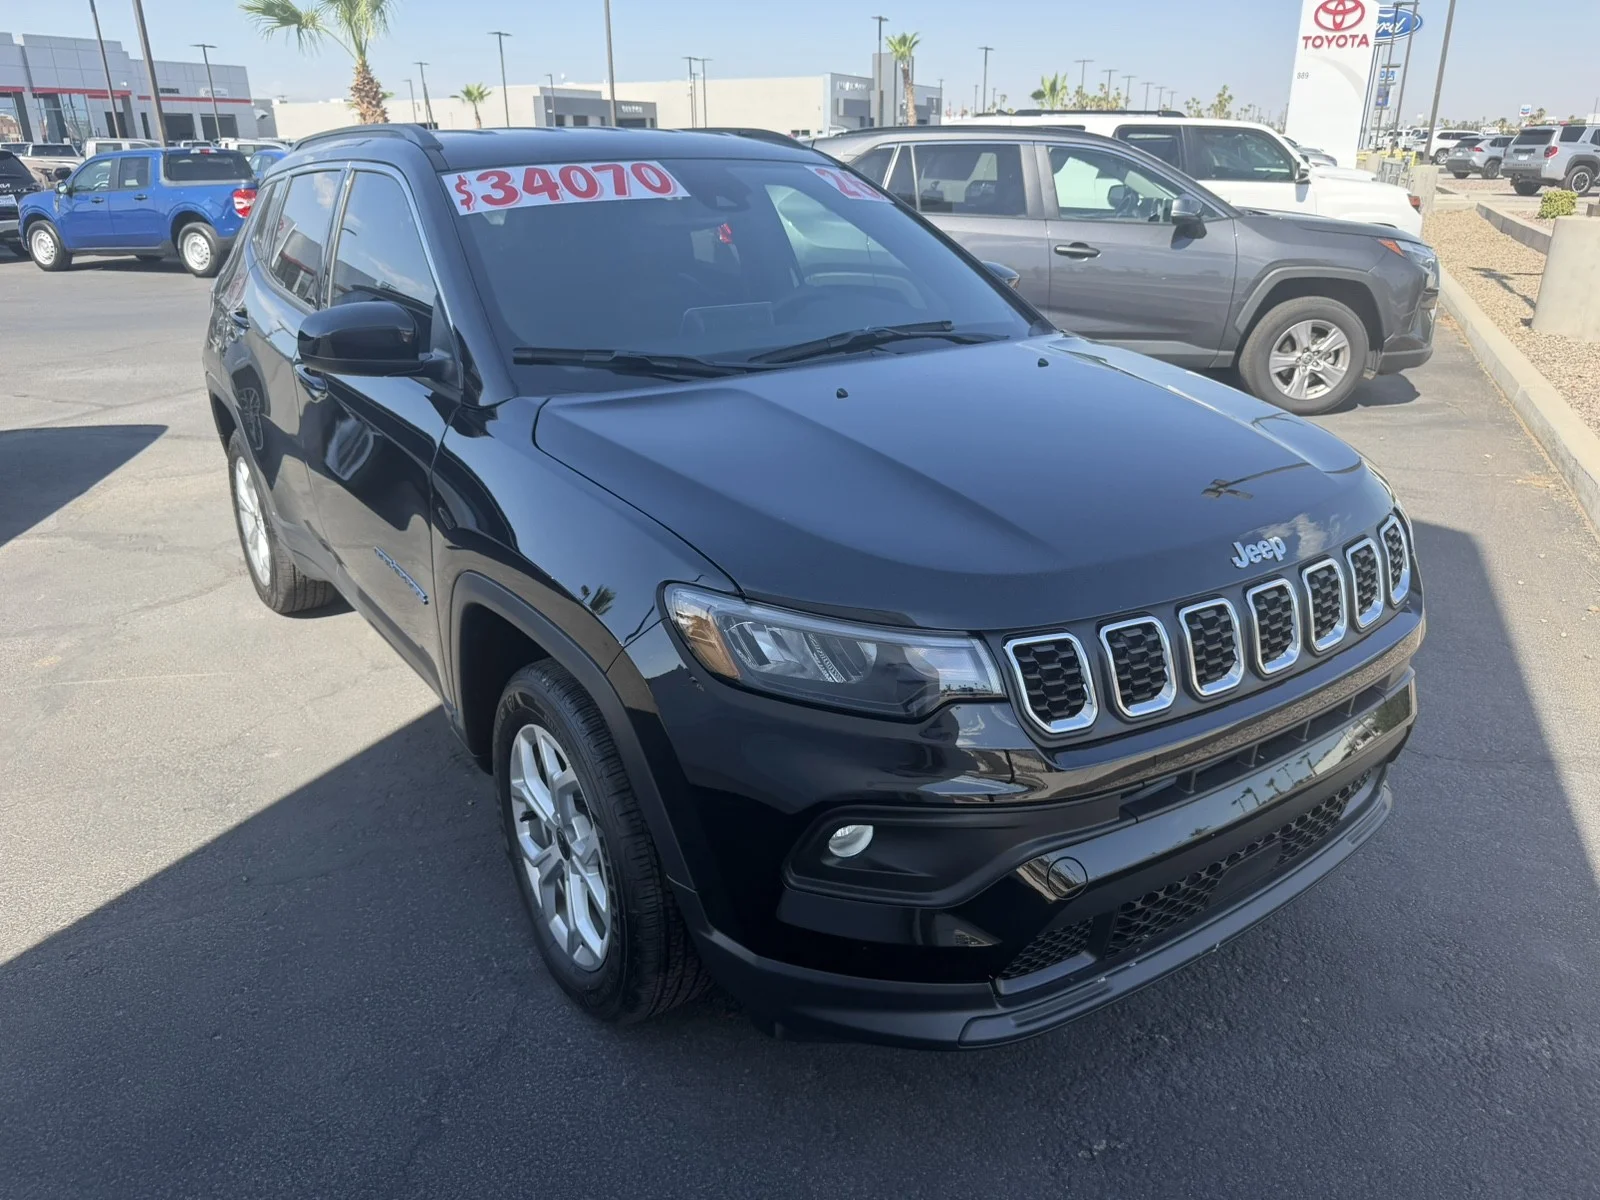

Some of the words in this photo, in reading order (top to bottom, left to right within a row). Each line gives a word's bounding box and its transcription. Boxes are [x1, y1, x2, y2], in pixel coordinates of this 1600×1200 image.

[1302, 34, 1370, 49] TOYOTA
[454, 162, 677, 212] $34070
[1230, 536, 1287, 568] Jeep
